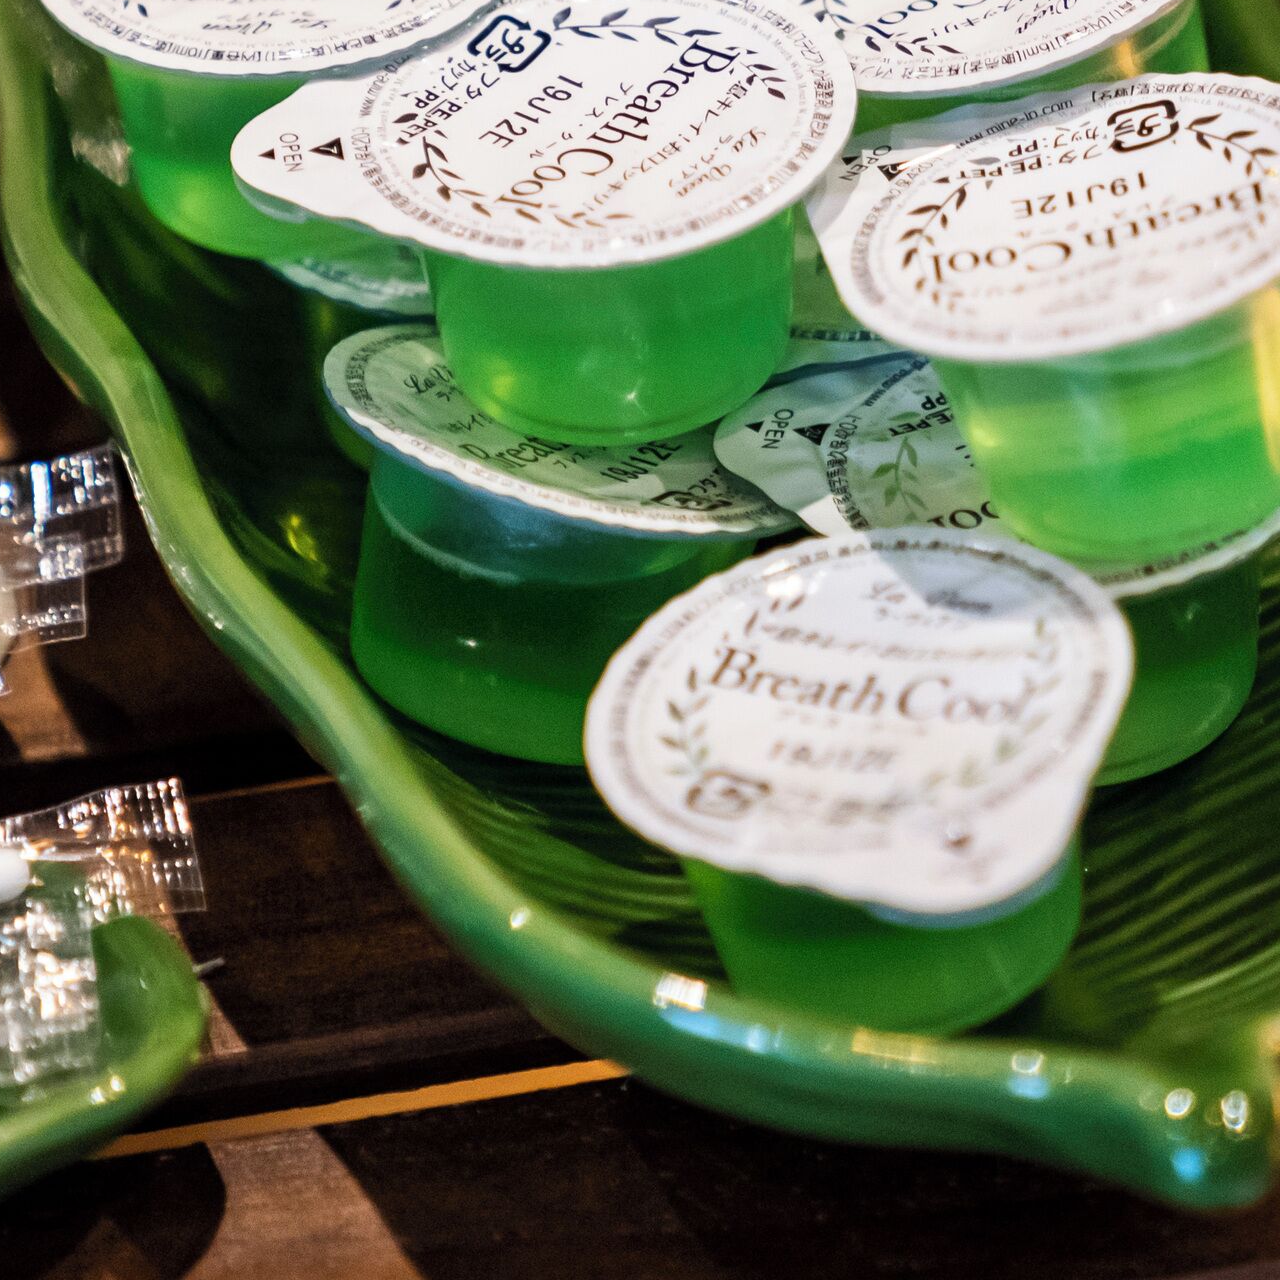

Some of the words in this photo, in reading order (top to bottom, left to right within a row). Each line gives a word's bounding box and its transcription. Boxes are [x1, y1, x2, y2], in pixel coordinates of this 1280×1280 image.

[478, 74, 584, 149] 19J12E
[586, 39, 742, 144] Breath
[278, 132, 303, 173] OPEN
[494, 147, 615, 210] Cool
[839, 144, 893, 182] OPEN
[1011, 171, 1149, 219] 19J12E
[1084, 182, 1264, 249] Breath
[930, 240, 1073, 285] Cool
[761, 408, 794, 450] OPEN
[711, 647, 886, 714] Breath
